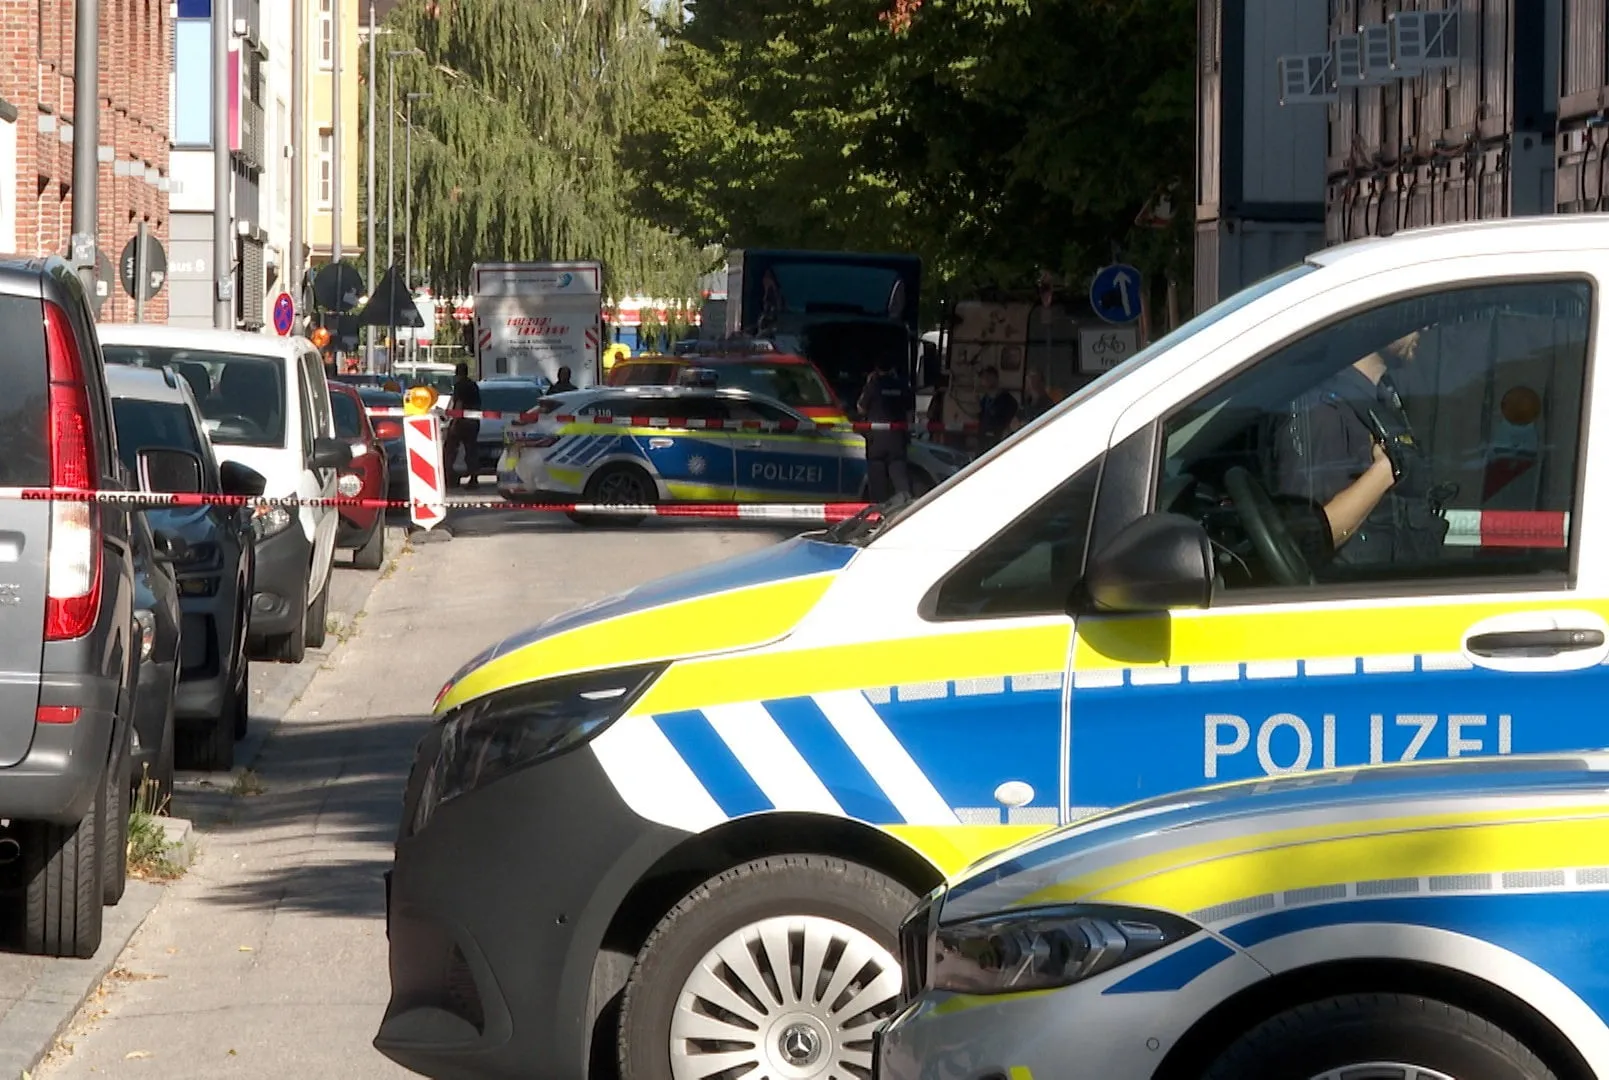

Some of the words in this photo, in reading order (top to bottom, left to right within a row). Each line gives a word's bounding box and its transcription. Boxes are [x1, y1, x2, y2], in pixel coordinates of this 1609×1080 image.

[196, 258, 206, 273] 8
[751, 462, 823, 483] POLIZEI
[1204, 713, 1512, 779] POLIZEI
